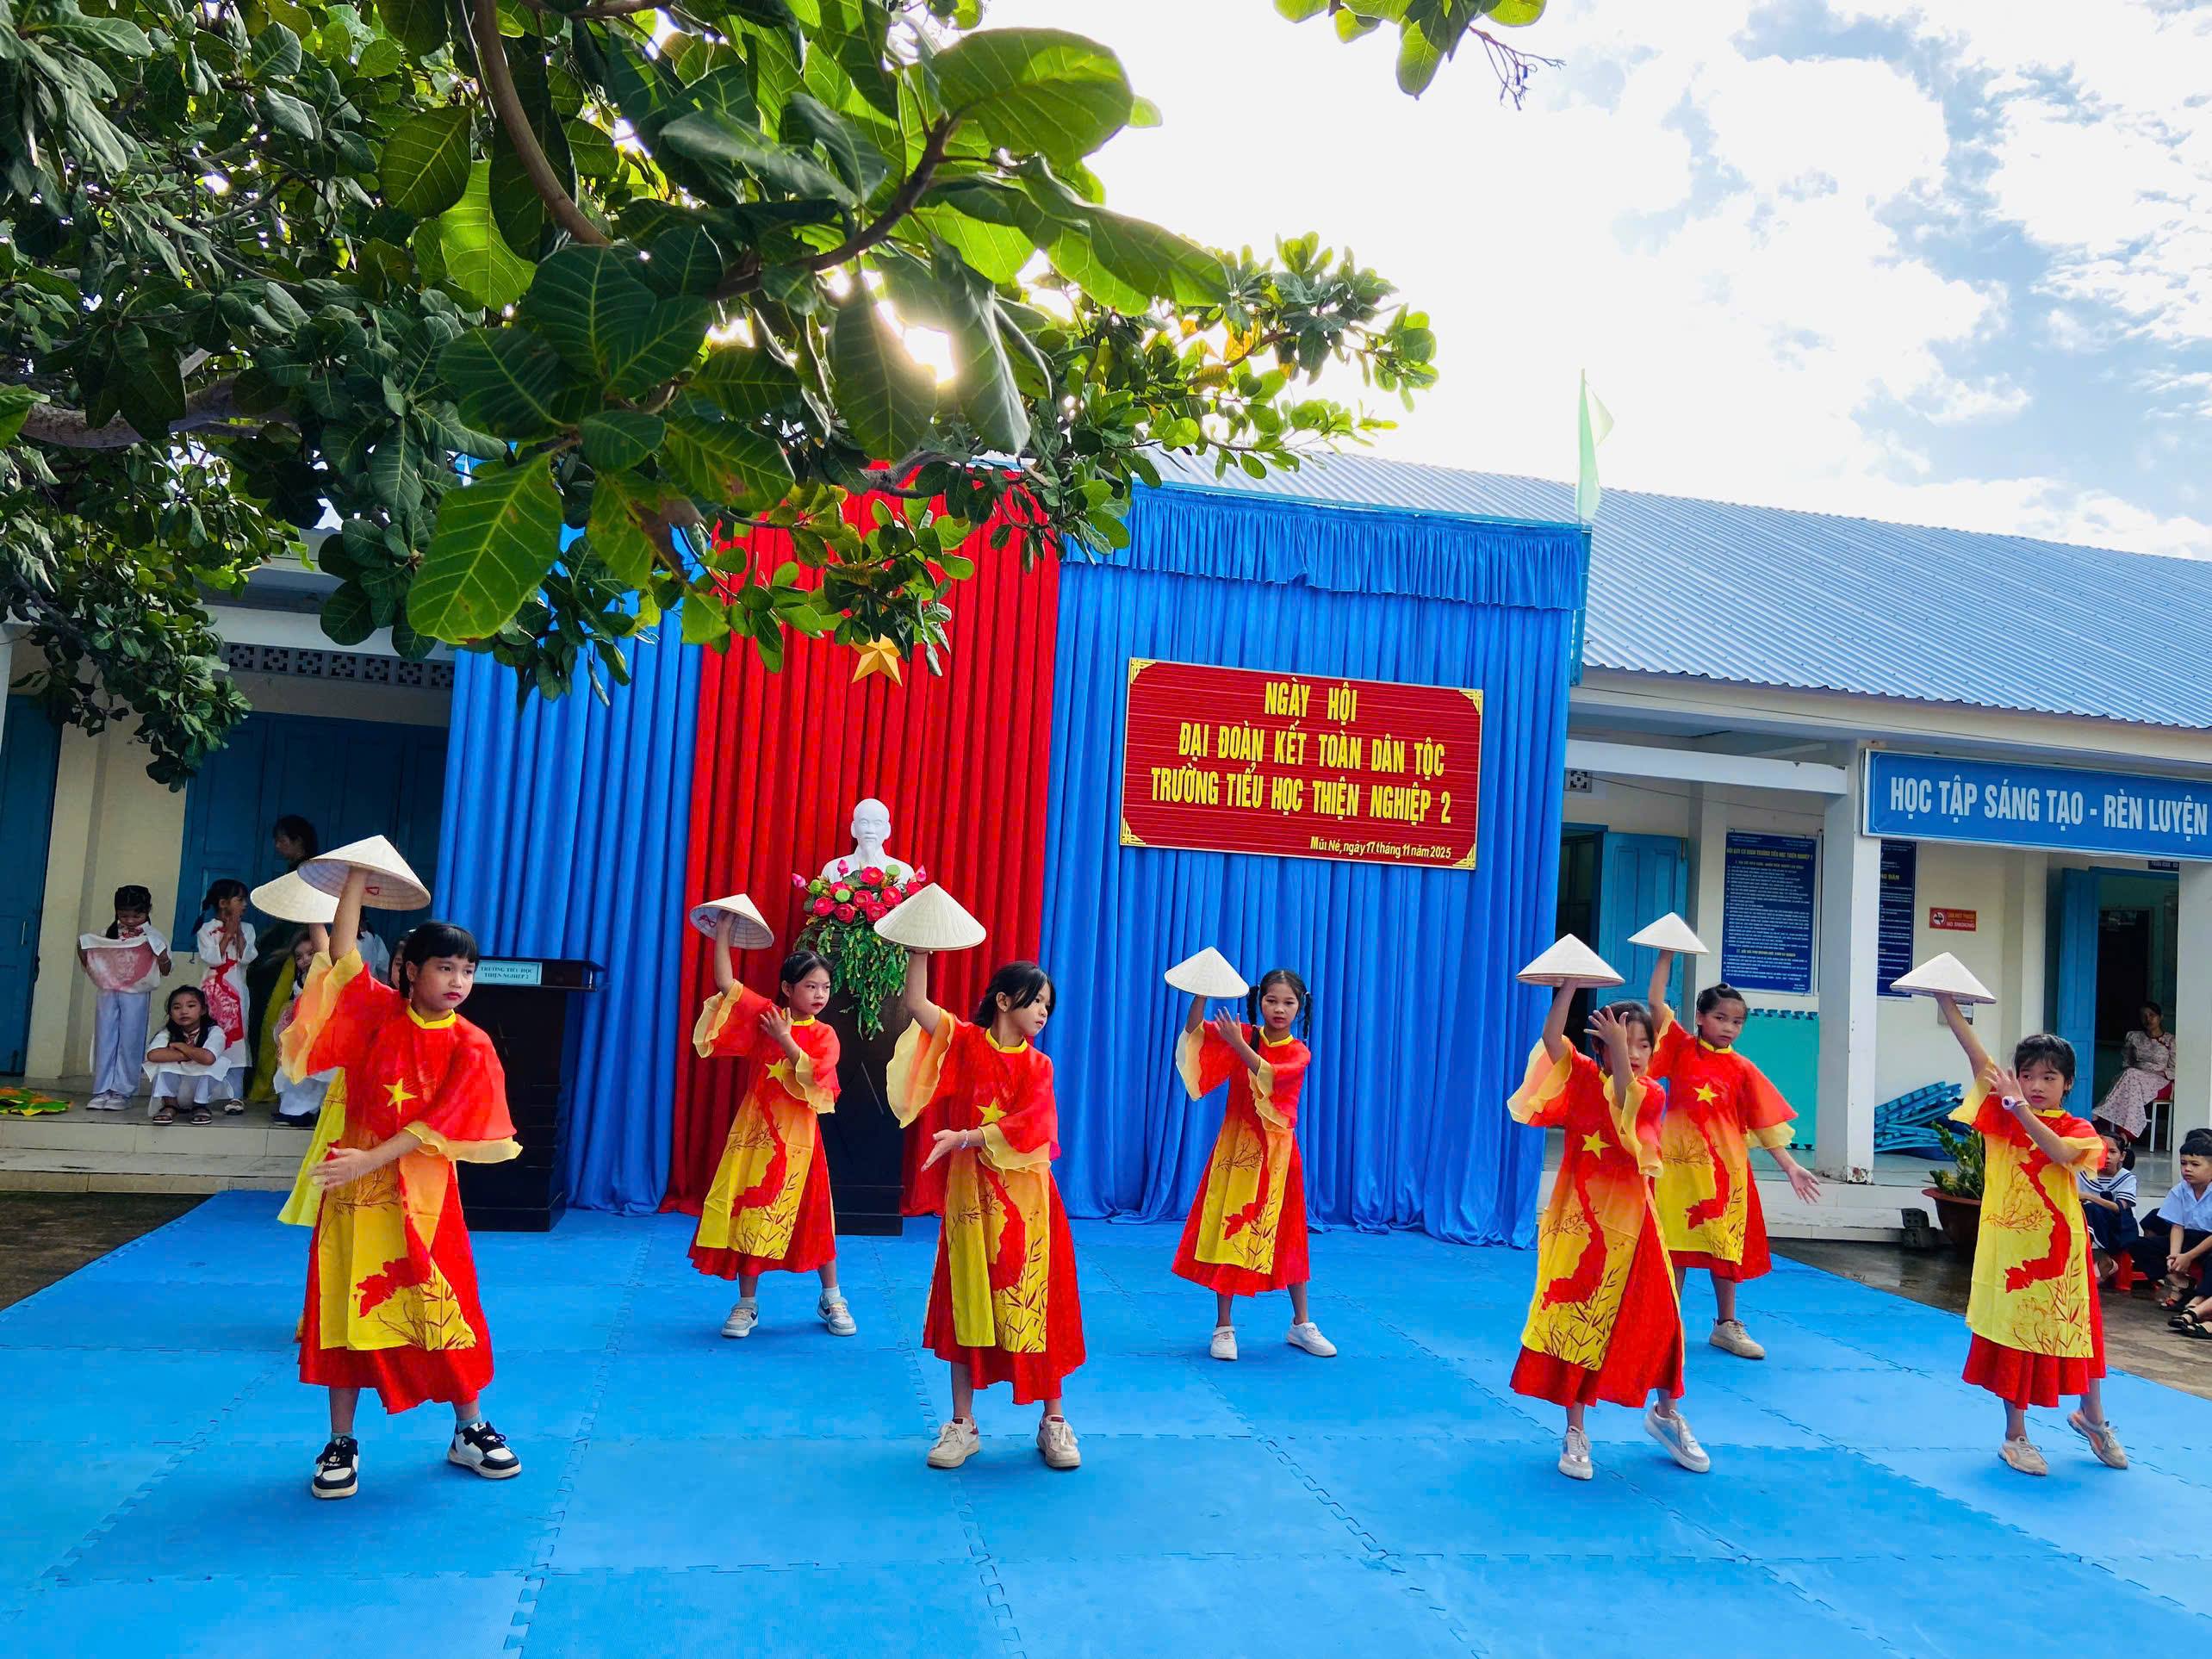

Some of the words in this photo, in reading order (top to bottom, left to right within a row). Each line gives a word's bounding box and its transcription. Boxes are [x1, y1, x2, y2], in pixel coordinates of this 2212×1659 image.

[1264, 676, 1310, 718] NGÀY
[1327, 681, 1357, 725] HỘI
[1178, 723, 1209, 761] ĐẠI
[1217, 720, 1264, 761] ĐOÀN
[1274, 720, 1307, 765] KẾT
[1319, 730, 1362, 769] TOÀN
[1371, 734, 1405, 773] DÂN
[1414, 737, 1445, 780] TỘC
[1151, 761, 1219, 805] TRƯỜNG
[1227, 762, 1264, 808] TIỂU
[1271, 776, 1303, 816] HỌC
[1313, 776, 1359, 820] THIỆN
[1370, 782, 1431, 826] NGHIỆP
[1440, 792, 1451, 823] 2
[1891, 777, 1931, 819] HỌC
[1938, 775, 1977, 823] TẬP
[1984, 780, 2040, 822] SÁNG
[2046, 790, 2083, 831] TẠO
[2103, 789, 2142, 830] RÈN
[2149, 795, 2208, 842] LUYỆN
[1310, 836, 1327, 850] Mũi
[1328, 839, 1342, 854] Né,
[1343, 841, 1365, 855] ngày
[1366, 842, 1376, 853] 17
[1376, 842, 1401, 859] tháng
[1402, 843, 1411, 855] 11
[1411, 845, 1430, 857] năm
[1430, 846, 1451, 859] 2025
